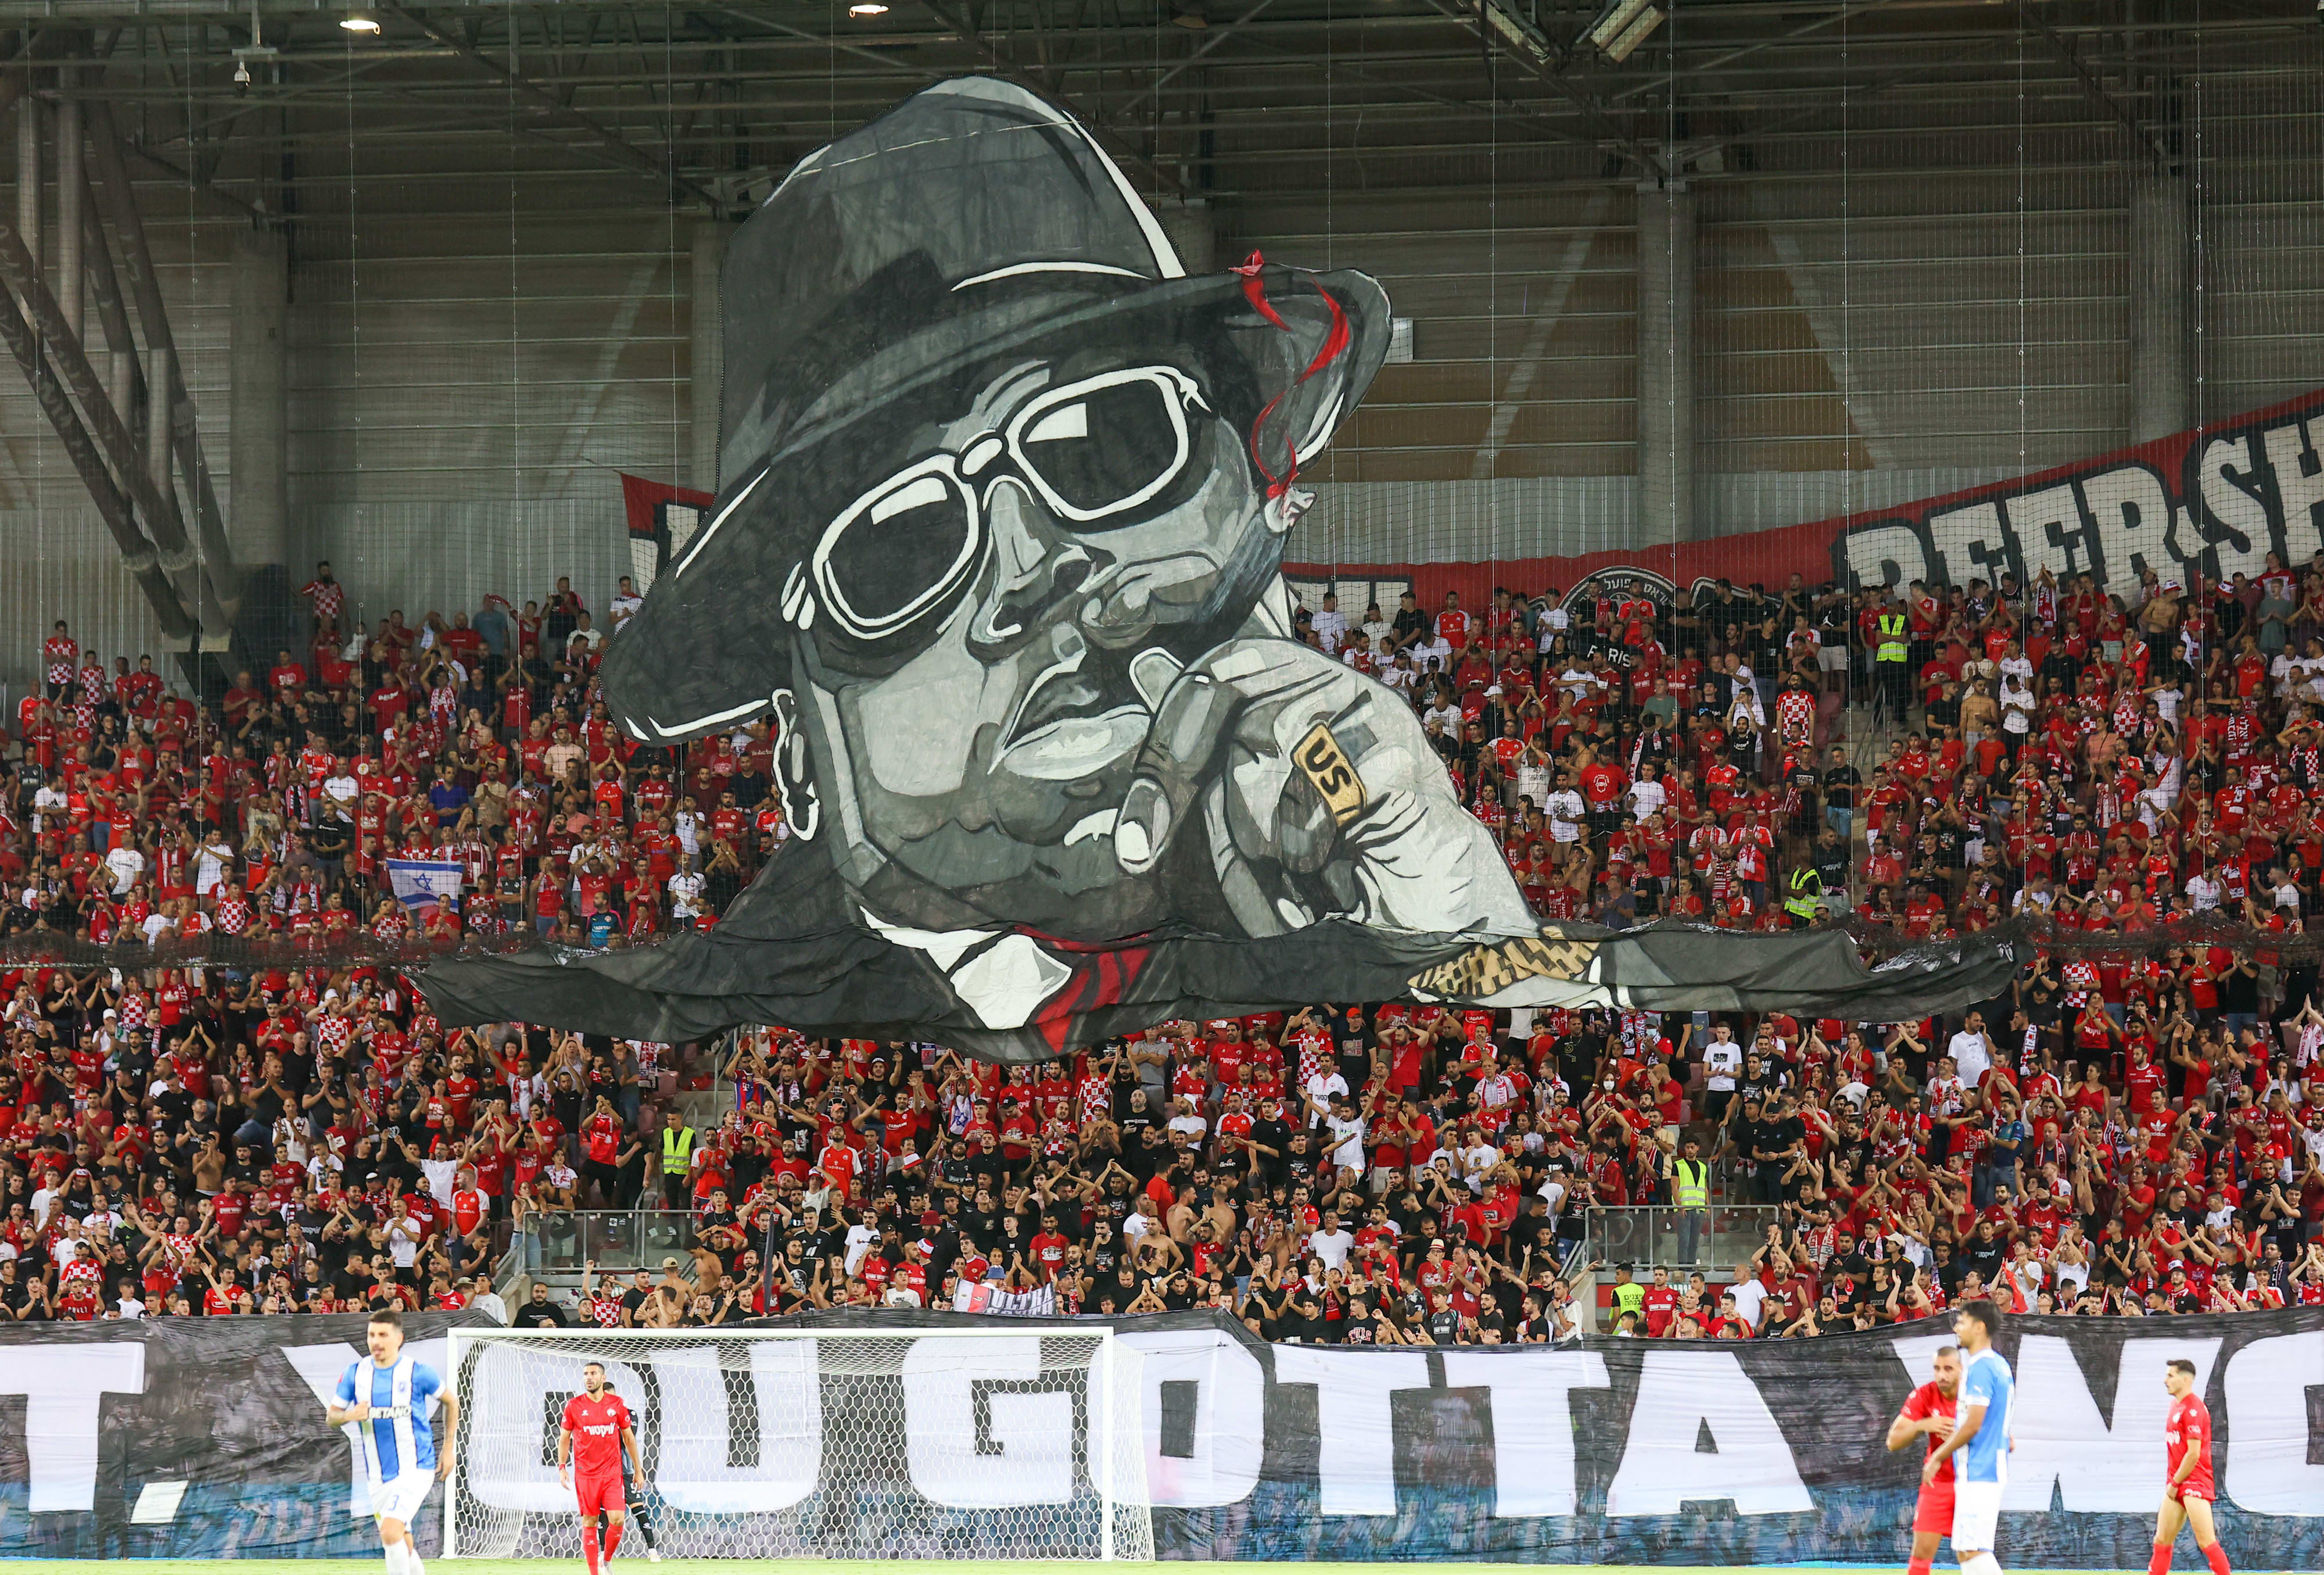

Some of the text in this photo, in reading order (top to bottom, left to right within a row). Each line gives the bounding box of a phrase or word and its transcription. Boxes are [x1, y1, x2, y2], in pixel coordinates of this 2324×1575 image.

[1587, 645, 1631, 668] FRIS
[1306, 738, 1352, 796] US
[991, 1282, 1053, 1310] ULTRA
[368, 1405, 412, 1420] BETANO
[902, 1329, 1816, 1518] GOTTA
[583, 1422, 616, 1437] ויקטורי
